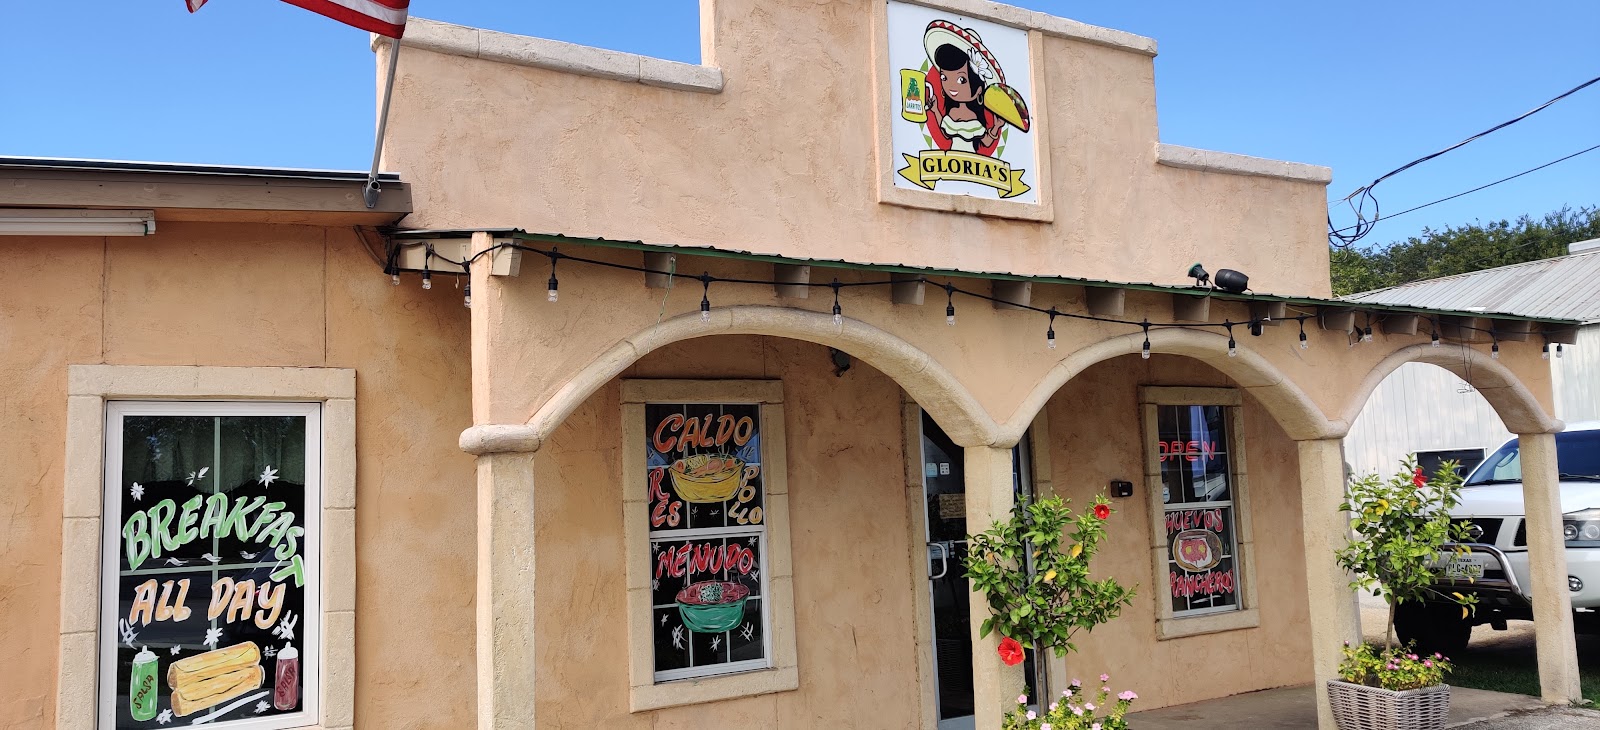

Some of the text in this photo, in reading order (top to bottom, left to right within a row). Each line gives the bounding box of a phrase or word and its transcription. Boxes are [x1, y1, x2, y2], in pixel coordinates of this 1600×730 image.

[922, 157, 1009, 183] GLORIA'S
[652, 413, 754, 453] CALDO
[1158, 440, 1216, 462] OPEN
[1165, 508, 1224, 535] HUEVOS
[122, 491, 305, 588] BREAKFAST
[656, 541, 755, 579] MENUDO
[1170, 568, 1235, 598] RANCHEROS
[128, 577, 287, 630] ALL DAY
[133, 674, 155, 709] SALSA
[276, 666, 297, 698] SALSA
